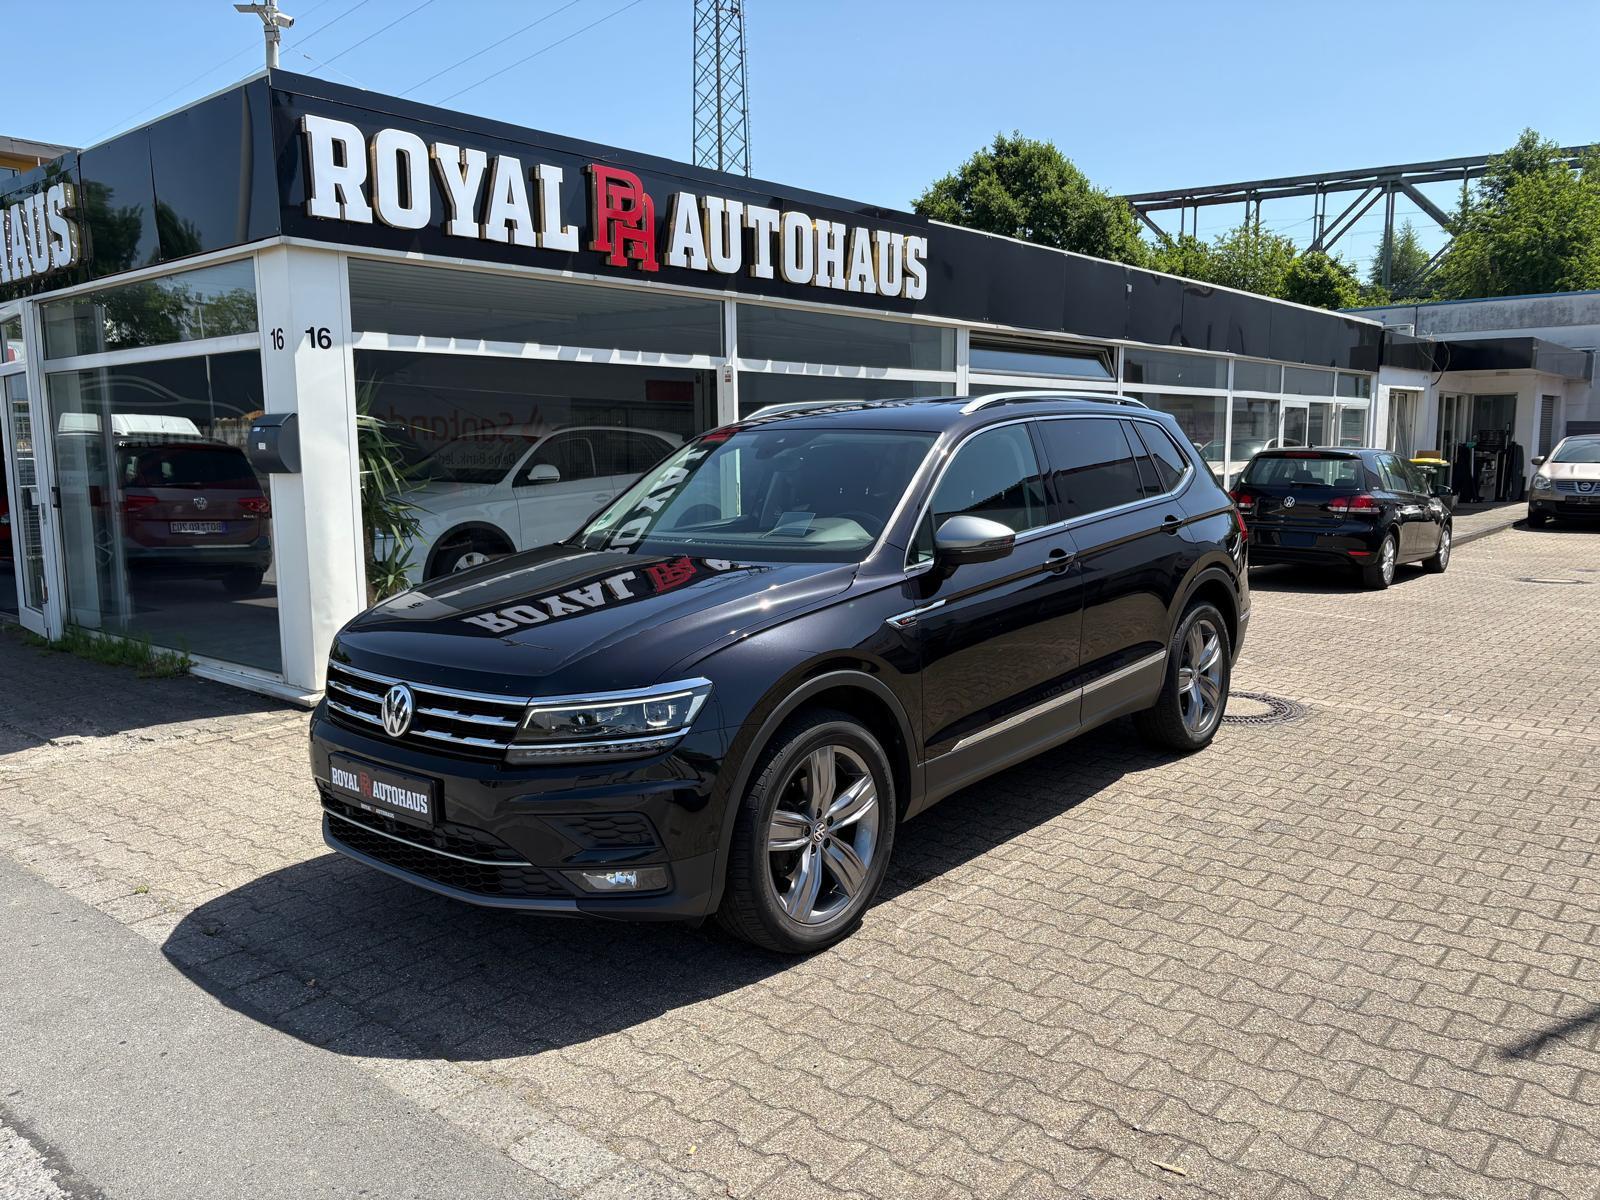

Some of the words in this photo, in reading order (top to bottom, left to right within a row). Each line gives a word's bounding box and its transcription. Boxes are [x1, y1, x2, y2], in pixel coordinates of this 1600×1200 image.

[304, 114, 579, 253] ROYAL
[665, 191, 928, 301] AUTOHAUS
[270, 327, 285, 351] 16
[305, 326, 332, 350] 16
[331, 766, 360, 793] ROYAL
[372, 780, 428, 814] AUTOHAUS
